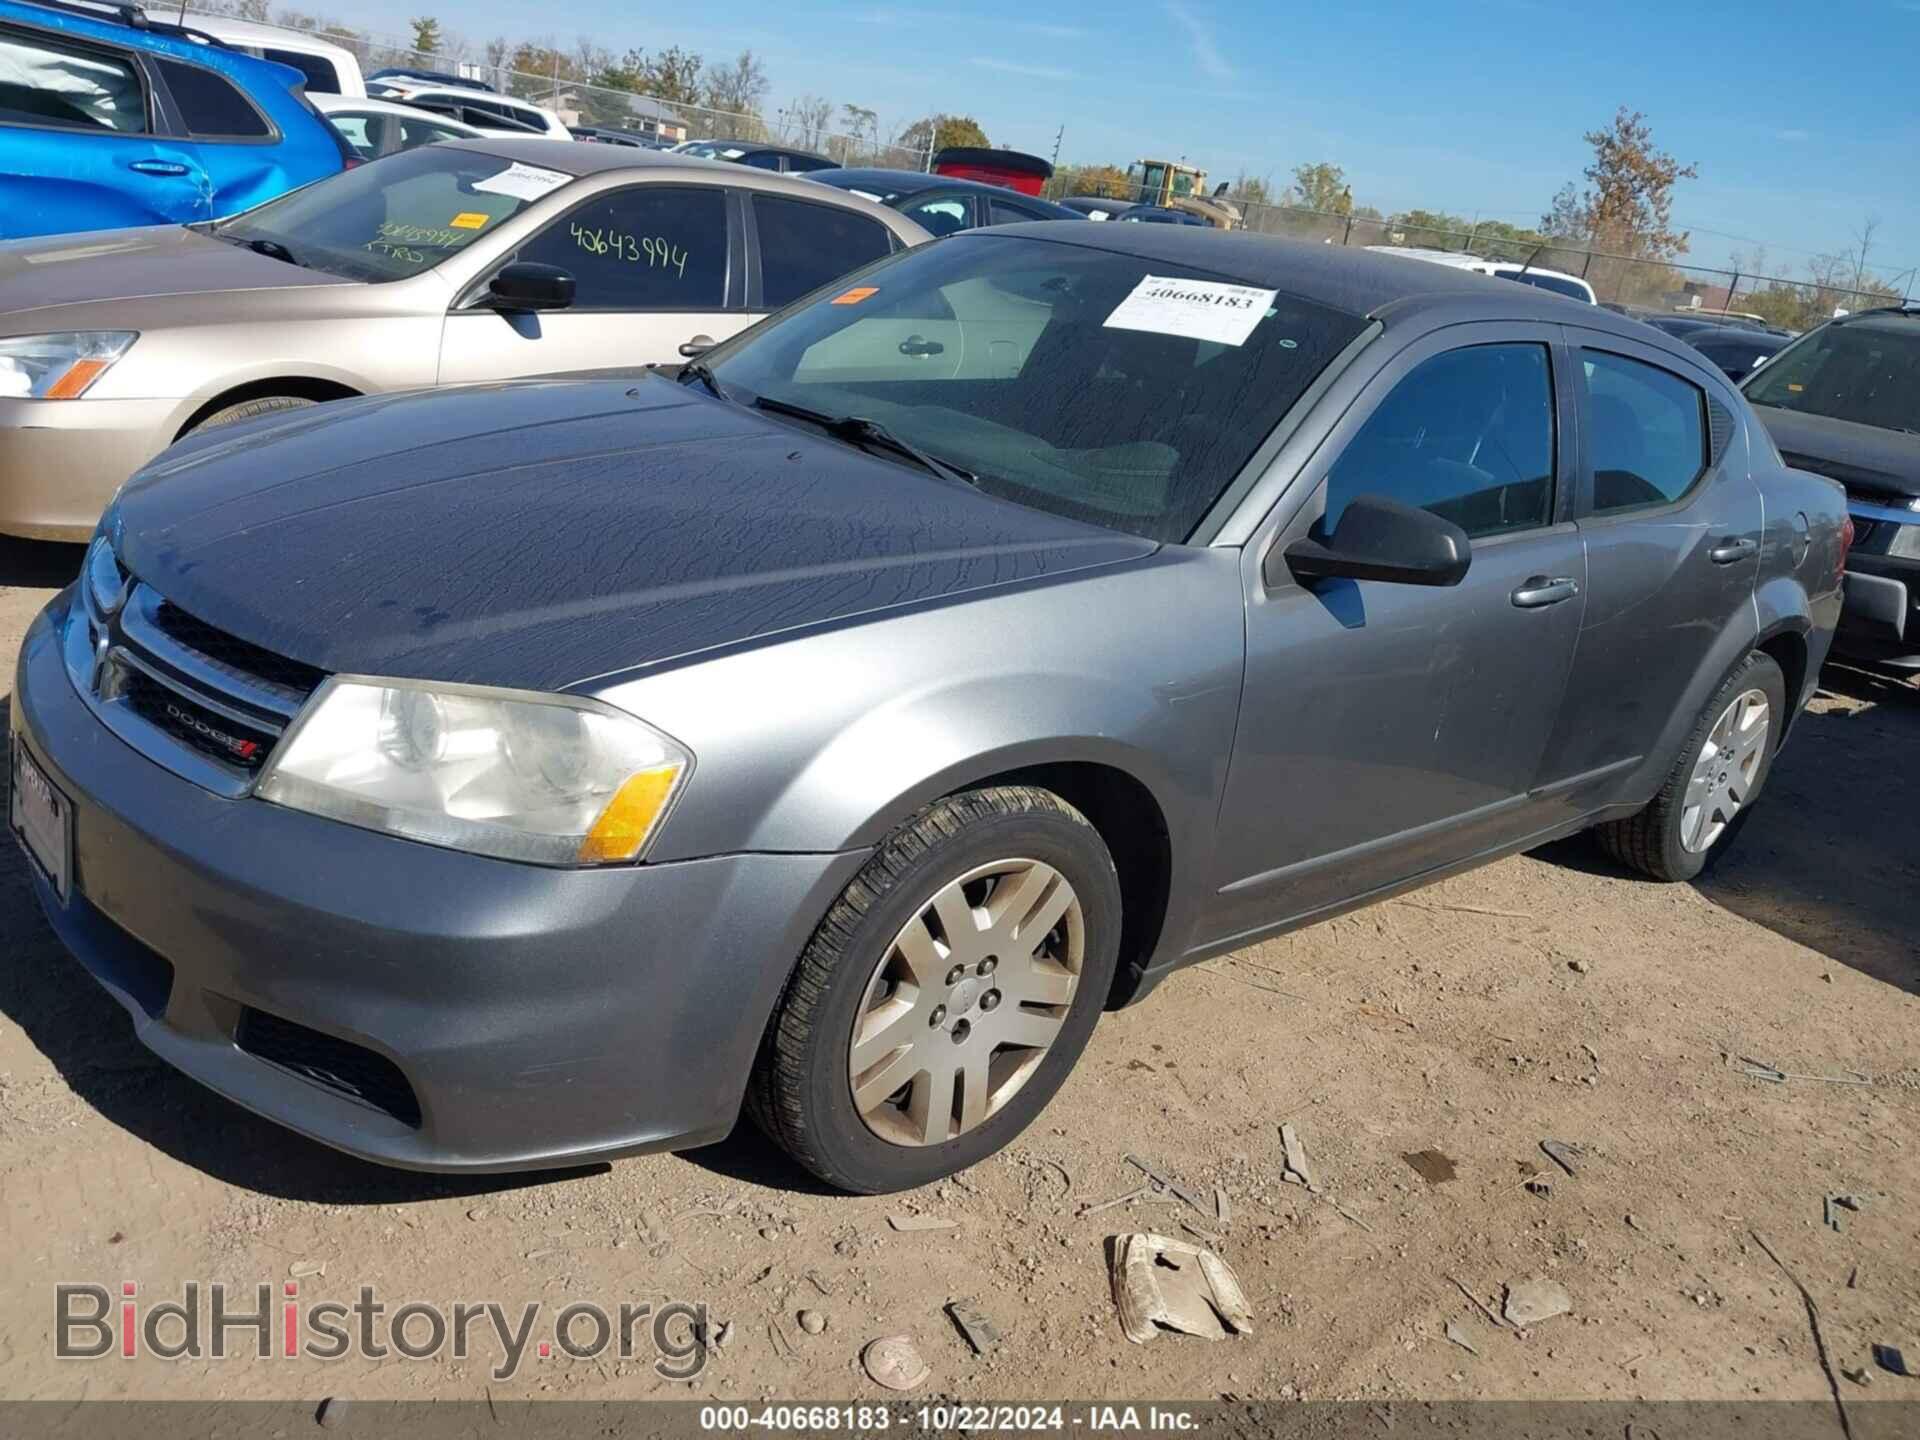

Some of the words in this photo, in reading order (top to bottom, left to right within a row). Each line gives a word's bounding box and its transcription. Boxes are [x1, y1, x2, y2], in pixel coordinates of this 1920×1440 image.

[570, 222, 688, 279] 40643994
[1146, 287, 1254, 310] 40668183
[167, 704, 242, 754] DODGE
